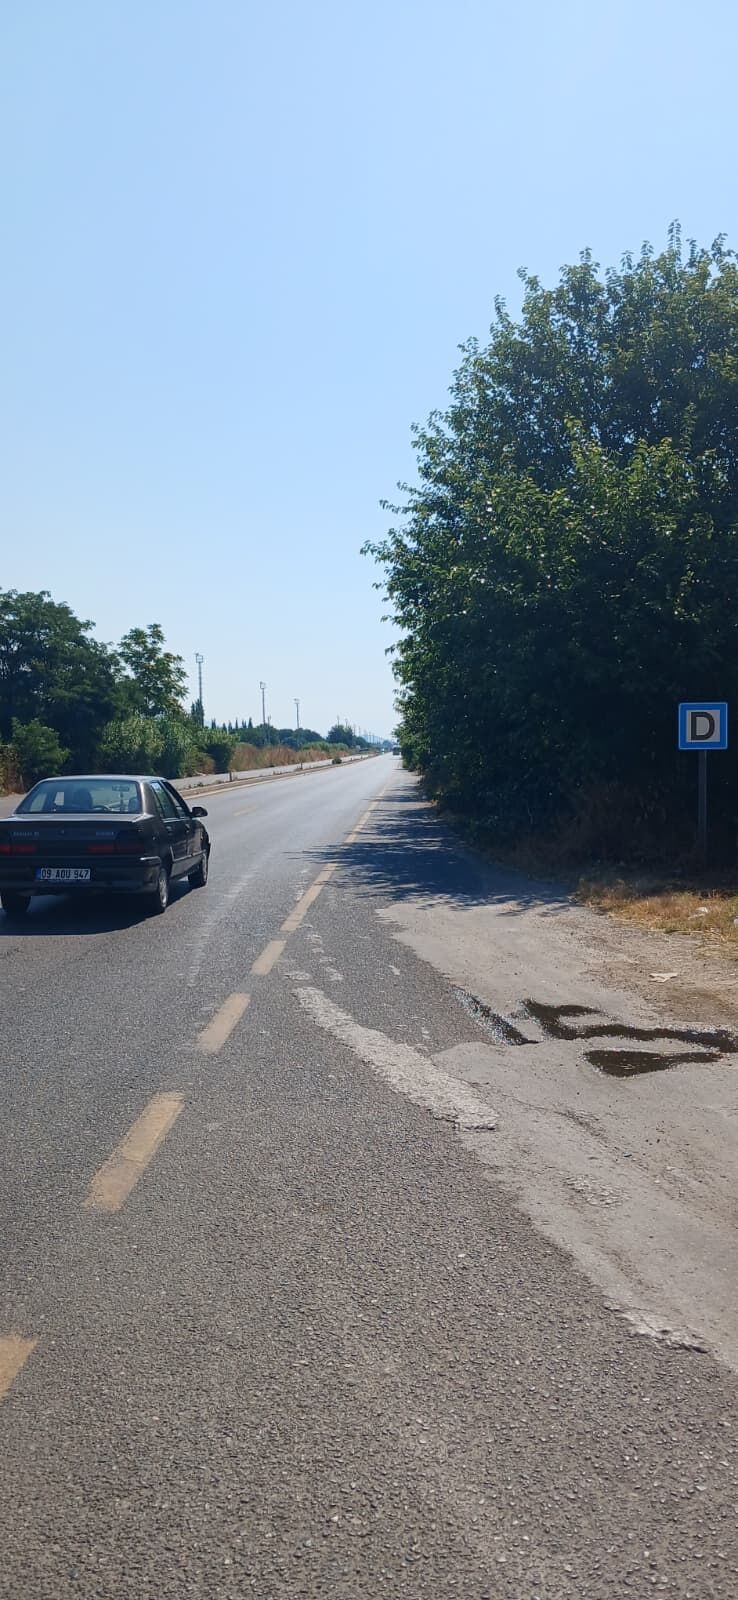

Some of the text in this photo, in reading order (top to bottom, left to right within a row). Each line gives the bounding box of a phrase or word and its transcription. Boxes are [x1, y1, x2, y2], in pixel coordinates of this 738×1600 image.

[690, 711, 715, 741] D
[41, 869, 52, 879] 09
[74, 869, 89, 879] 947
